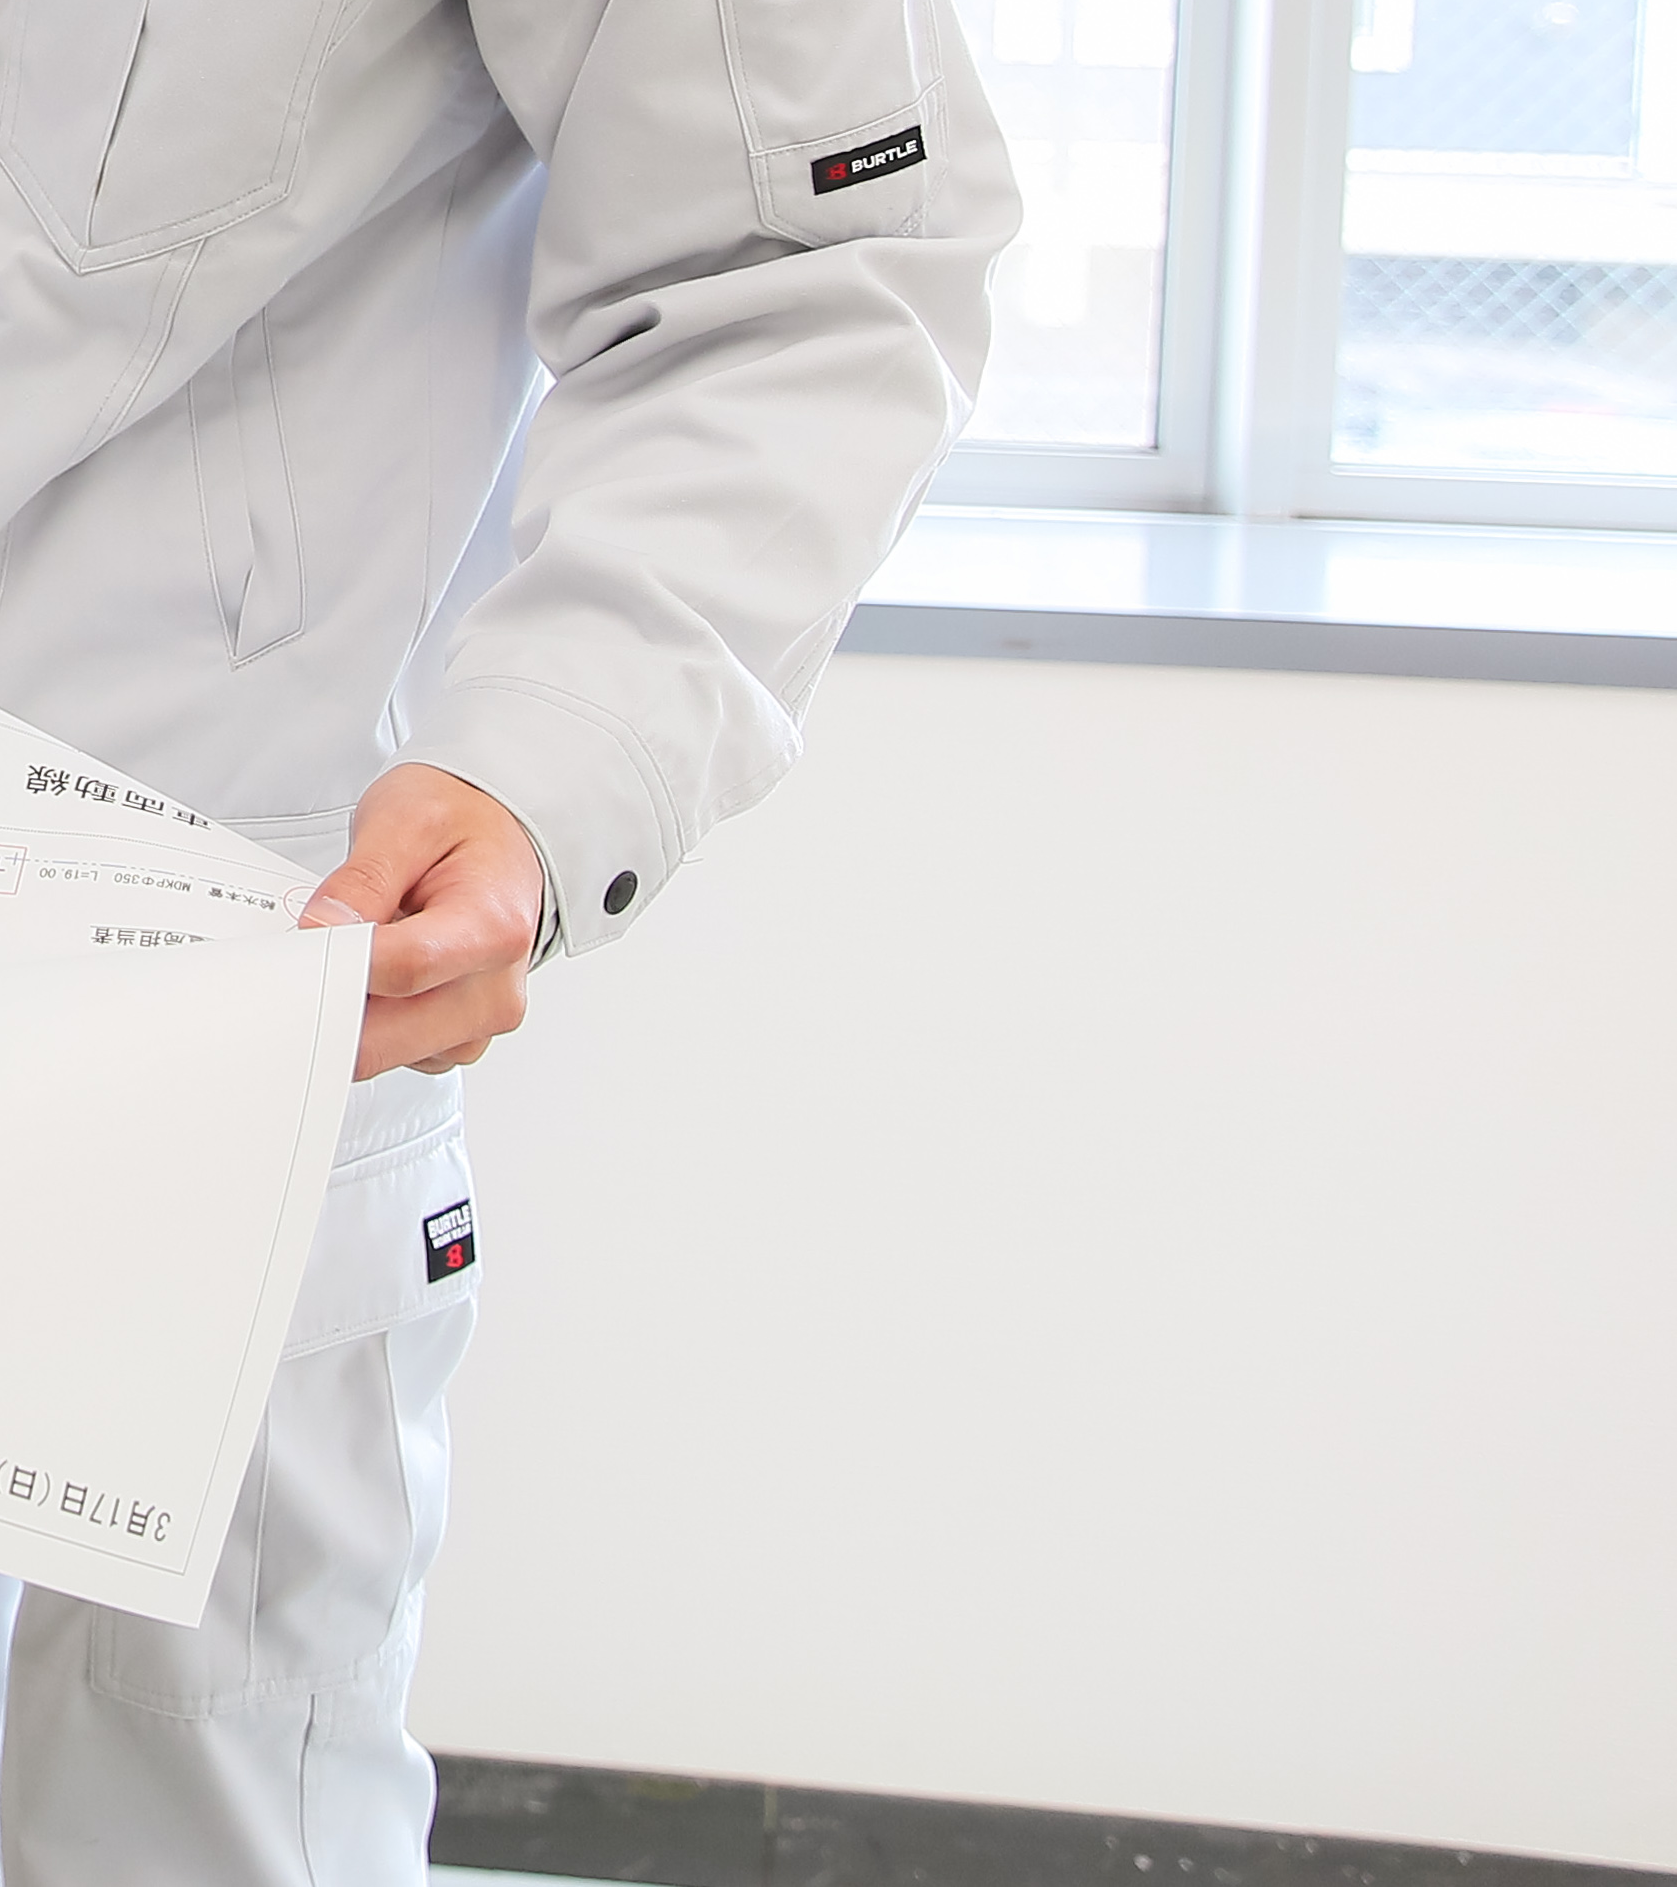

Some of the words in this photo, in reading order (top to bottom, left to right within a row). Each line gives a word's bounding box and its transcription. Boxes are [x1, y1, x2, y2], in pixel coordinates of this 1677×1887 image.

[851, 139, 919, 174] BURTLE
[89, 925, 215, 942] 局担当者
